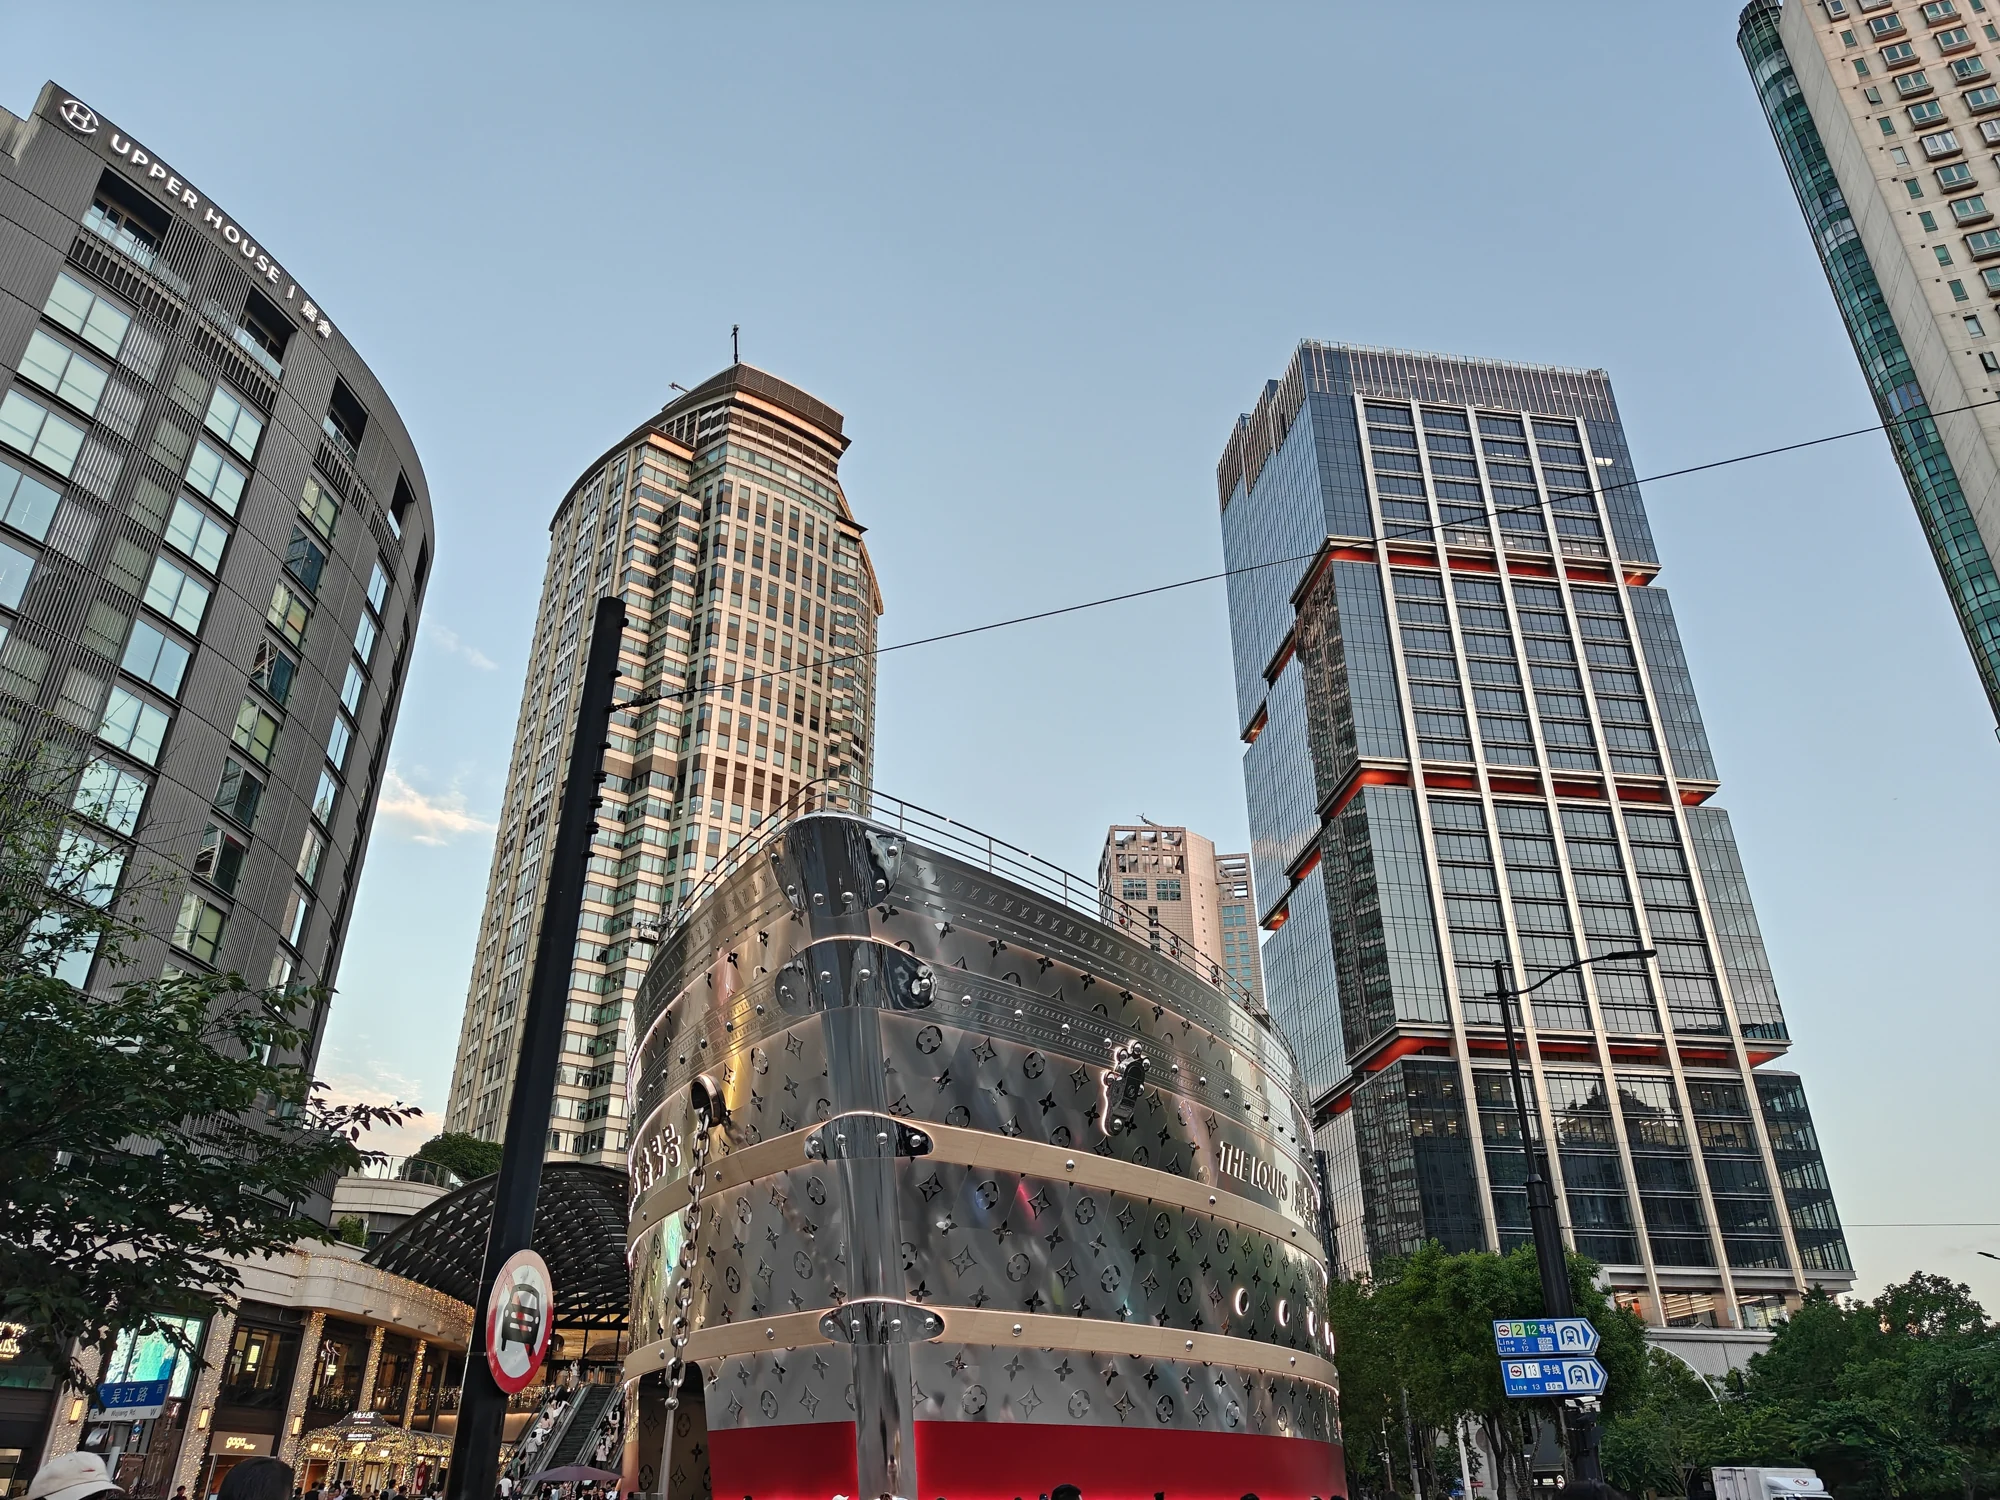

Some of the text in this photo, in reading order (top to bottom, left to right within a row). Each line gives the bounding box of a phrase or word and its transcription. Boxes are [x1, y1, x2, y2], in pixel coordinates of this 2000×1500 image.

[111, 133, 198, 210] UPPER
[204, 207, 280, 284] HOUSE
[300, 300, 332, 339] 居舍
[1219, 1140, 1288, 1202] THE LOUIS
[1514, 1324, 1556, 1336] 2 12 号线
[1527, 1364, 1561, 1377] 13 号线
[110, 1386, 149, 1404] 吴江路
[156, 1383, 164, 1394] 西
[92, 1411, 97, 1419] E
[111, 1409, 128, 1417] Wujiang
[150, 1408, 157, 1416] W
